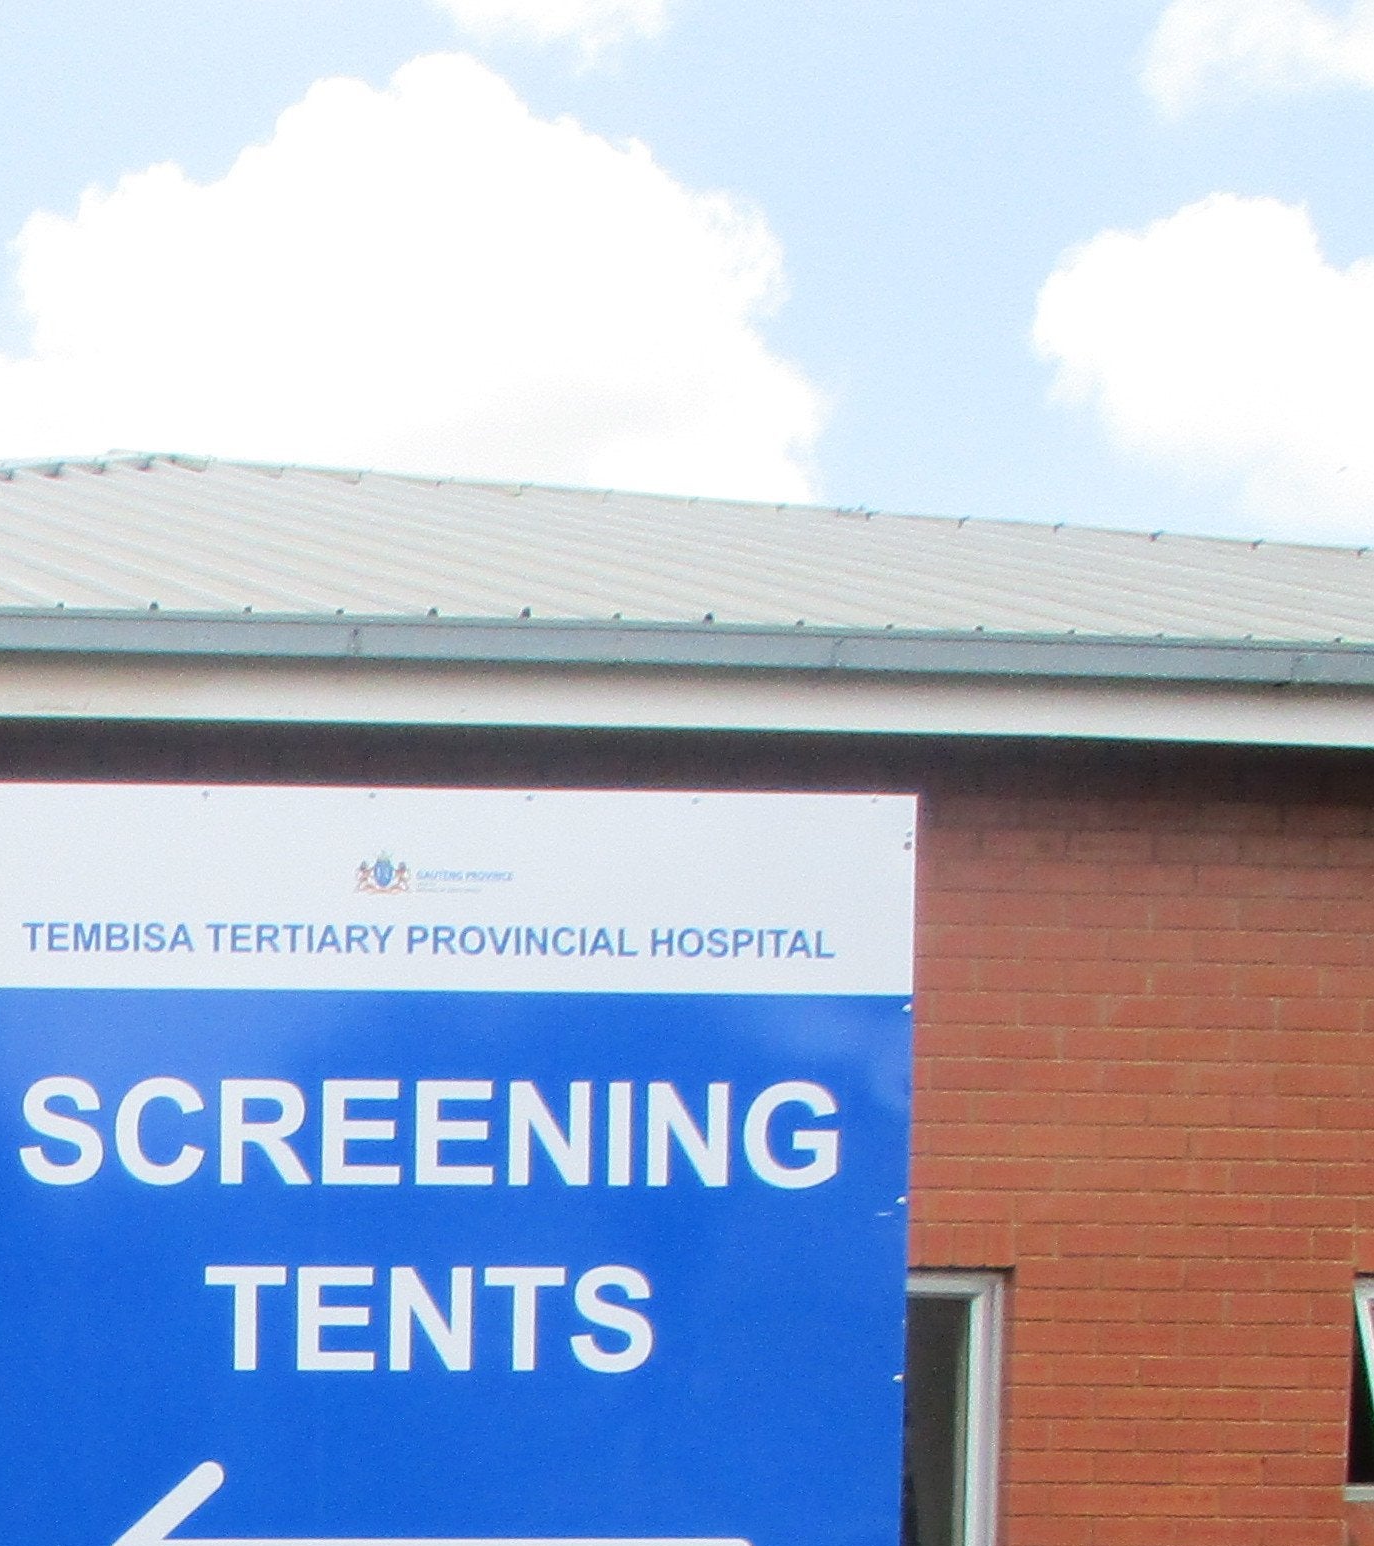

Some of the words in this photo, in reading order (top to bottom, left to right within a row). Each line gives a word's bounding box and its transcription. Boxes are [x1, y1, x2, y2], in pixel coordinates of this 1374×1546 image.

[22, 921, 194, 953] TEMBISA
[205, 922, 395, 954] TERTIARY
[406, 924, 640, 957] PROVINCIAL
[650, 926, 837, 959] HOSPITAL
[19, 1074, 840, 1189] SCREENING
[204, 1264, 654, 1373] TENTS
